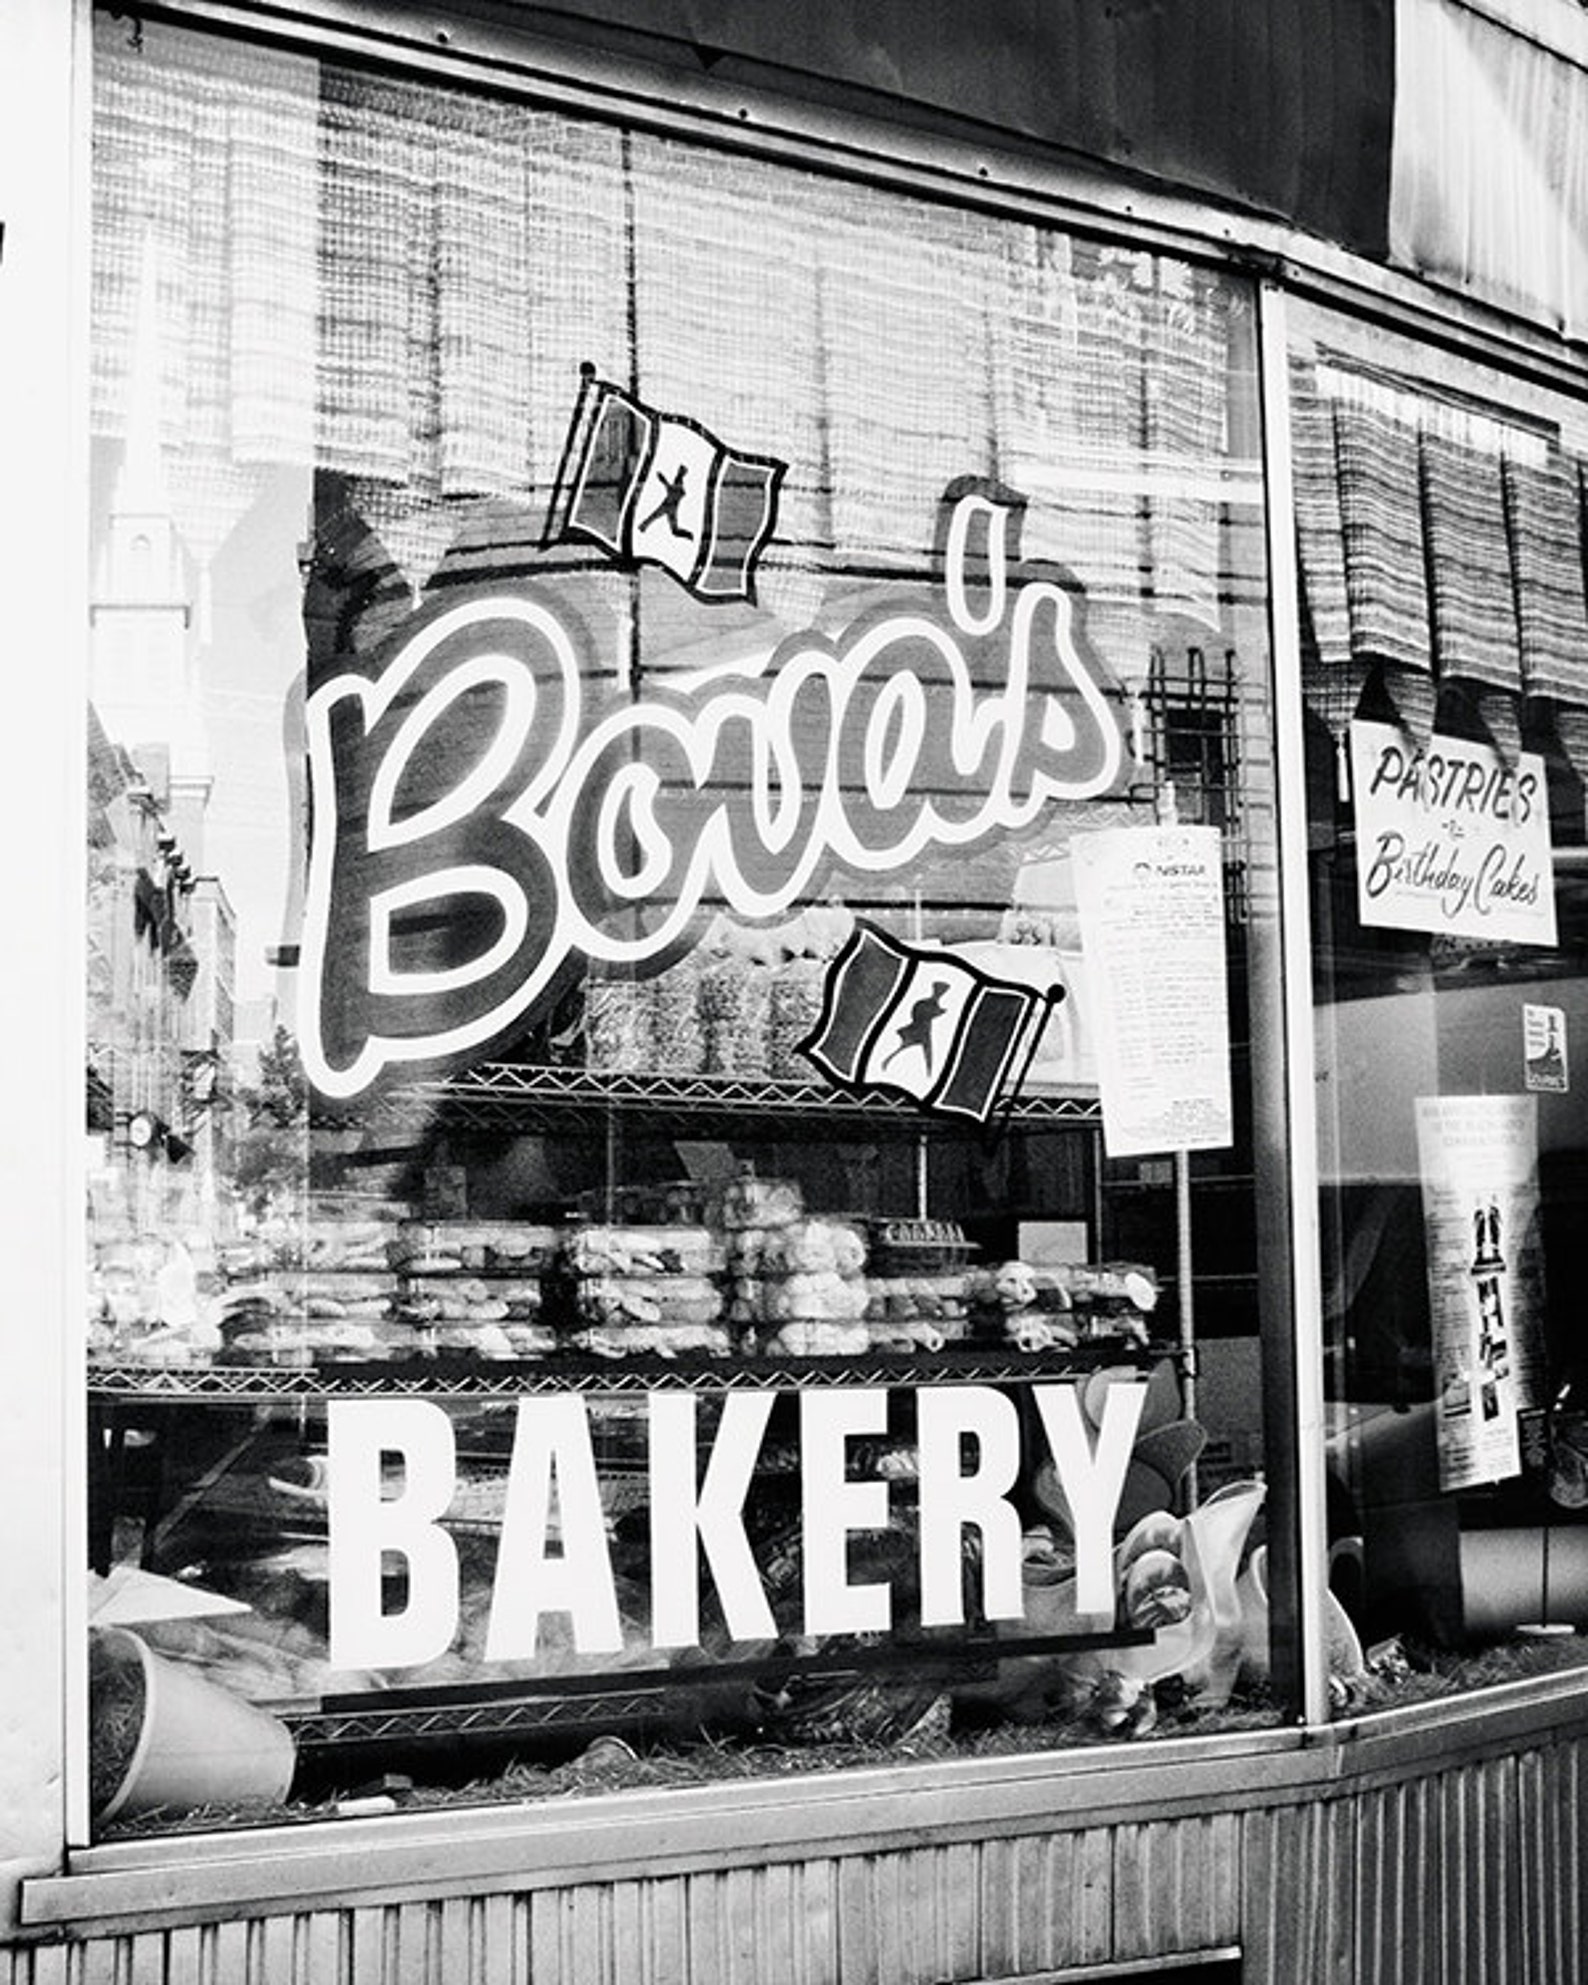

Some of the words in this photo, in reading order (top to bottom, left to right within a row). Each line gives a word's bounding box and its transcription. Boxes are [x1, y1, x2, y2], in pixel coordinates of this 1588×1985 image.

[300, 493, 1124, 1098] Bova's
[1366, 830, 1474, 919] Birthday
[1474, 843, 1540, 915] Cakes
[1370, 746, 1538, 823] PASTRIES
[327, 1383, 1149, 1672] BAKERY
